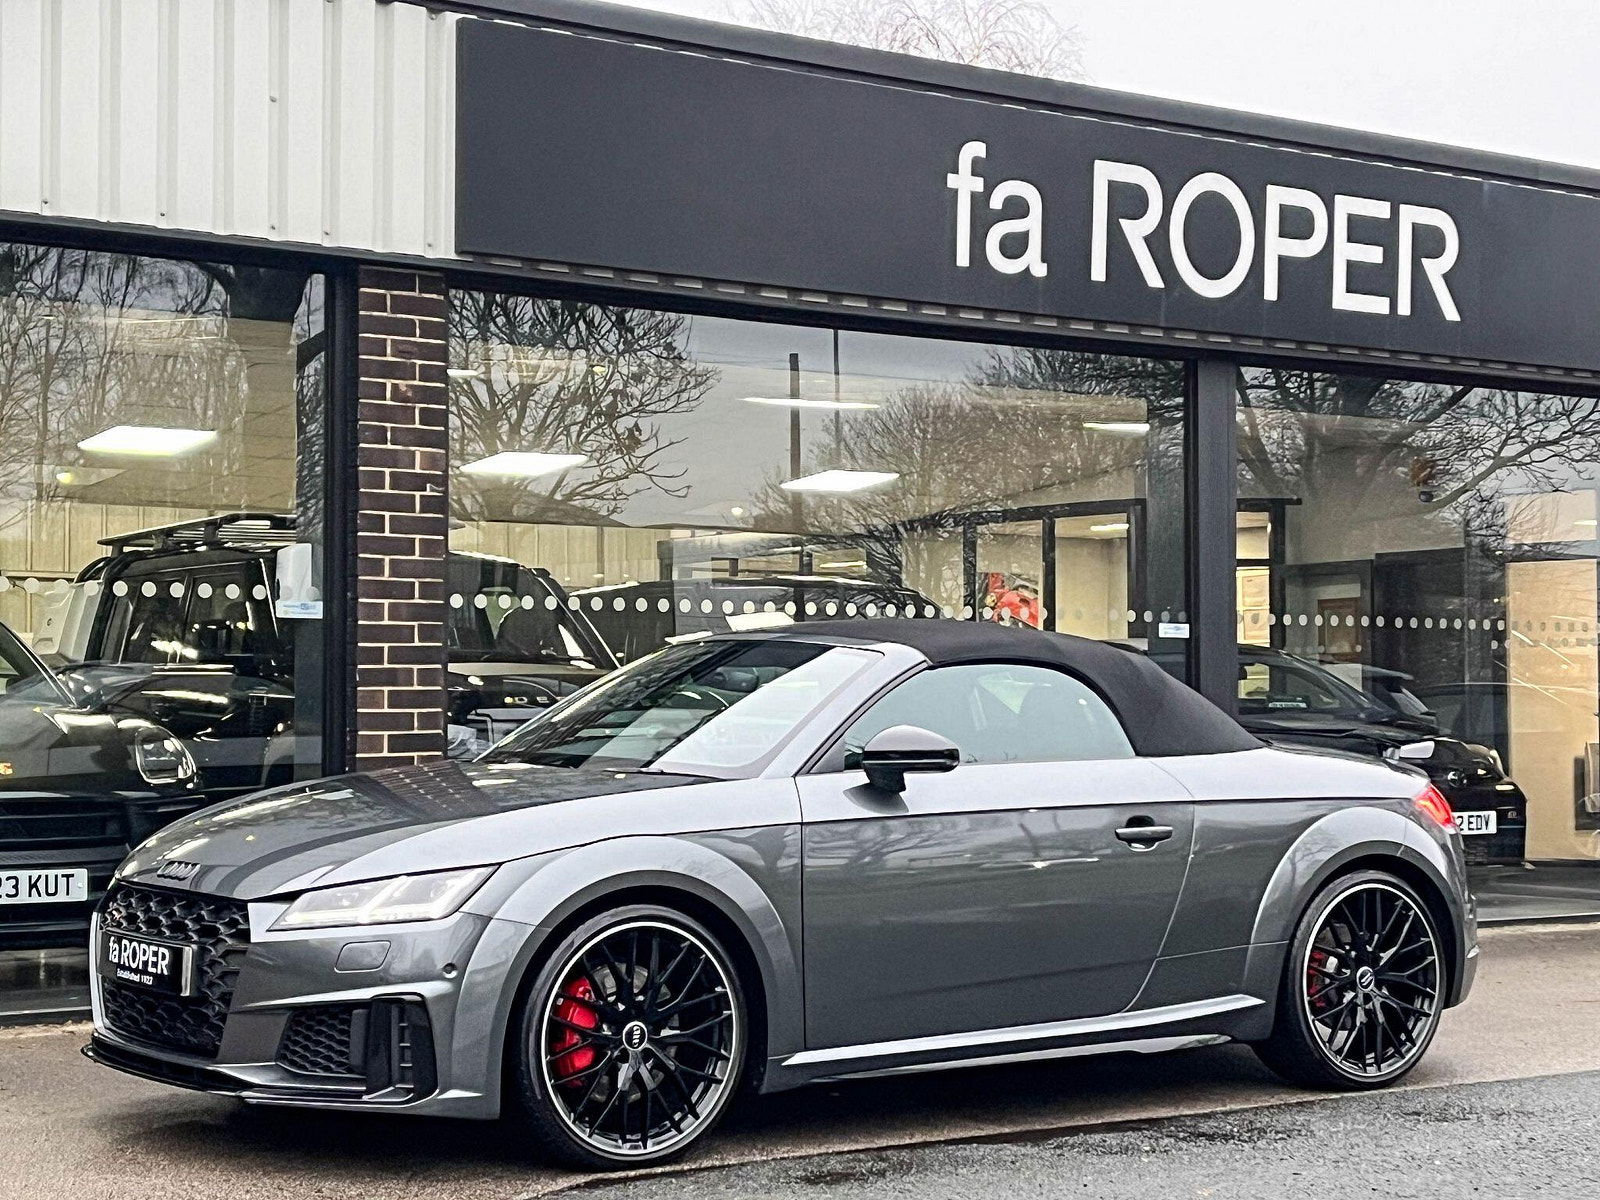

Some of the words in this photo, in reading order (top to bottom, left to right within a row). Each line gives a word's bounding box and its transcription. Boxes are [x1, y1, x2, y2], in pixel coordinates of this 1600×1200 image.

[946, 140, 1048, 278] fa
[1090, 158, 1462, 322] ROPER
[1467, 814, 1490, 831] EDV
[0, 875, 19, 899] 3
[28, 873, 75, 898] KUT
[109, 936, 119, 963] fa
[120, 939, 169, 975] ROPER
